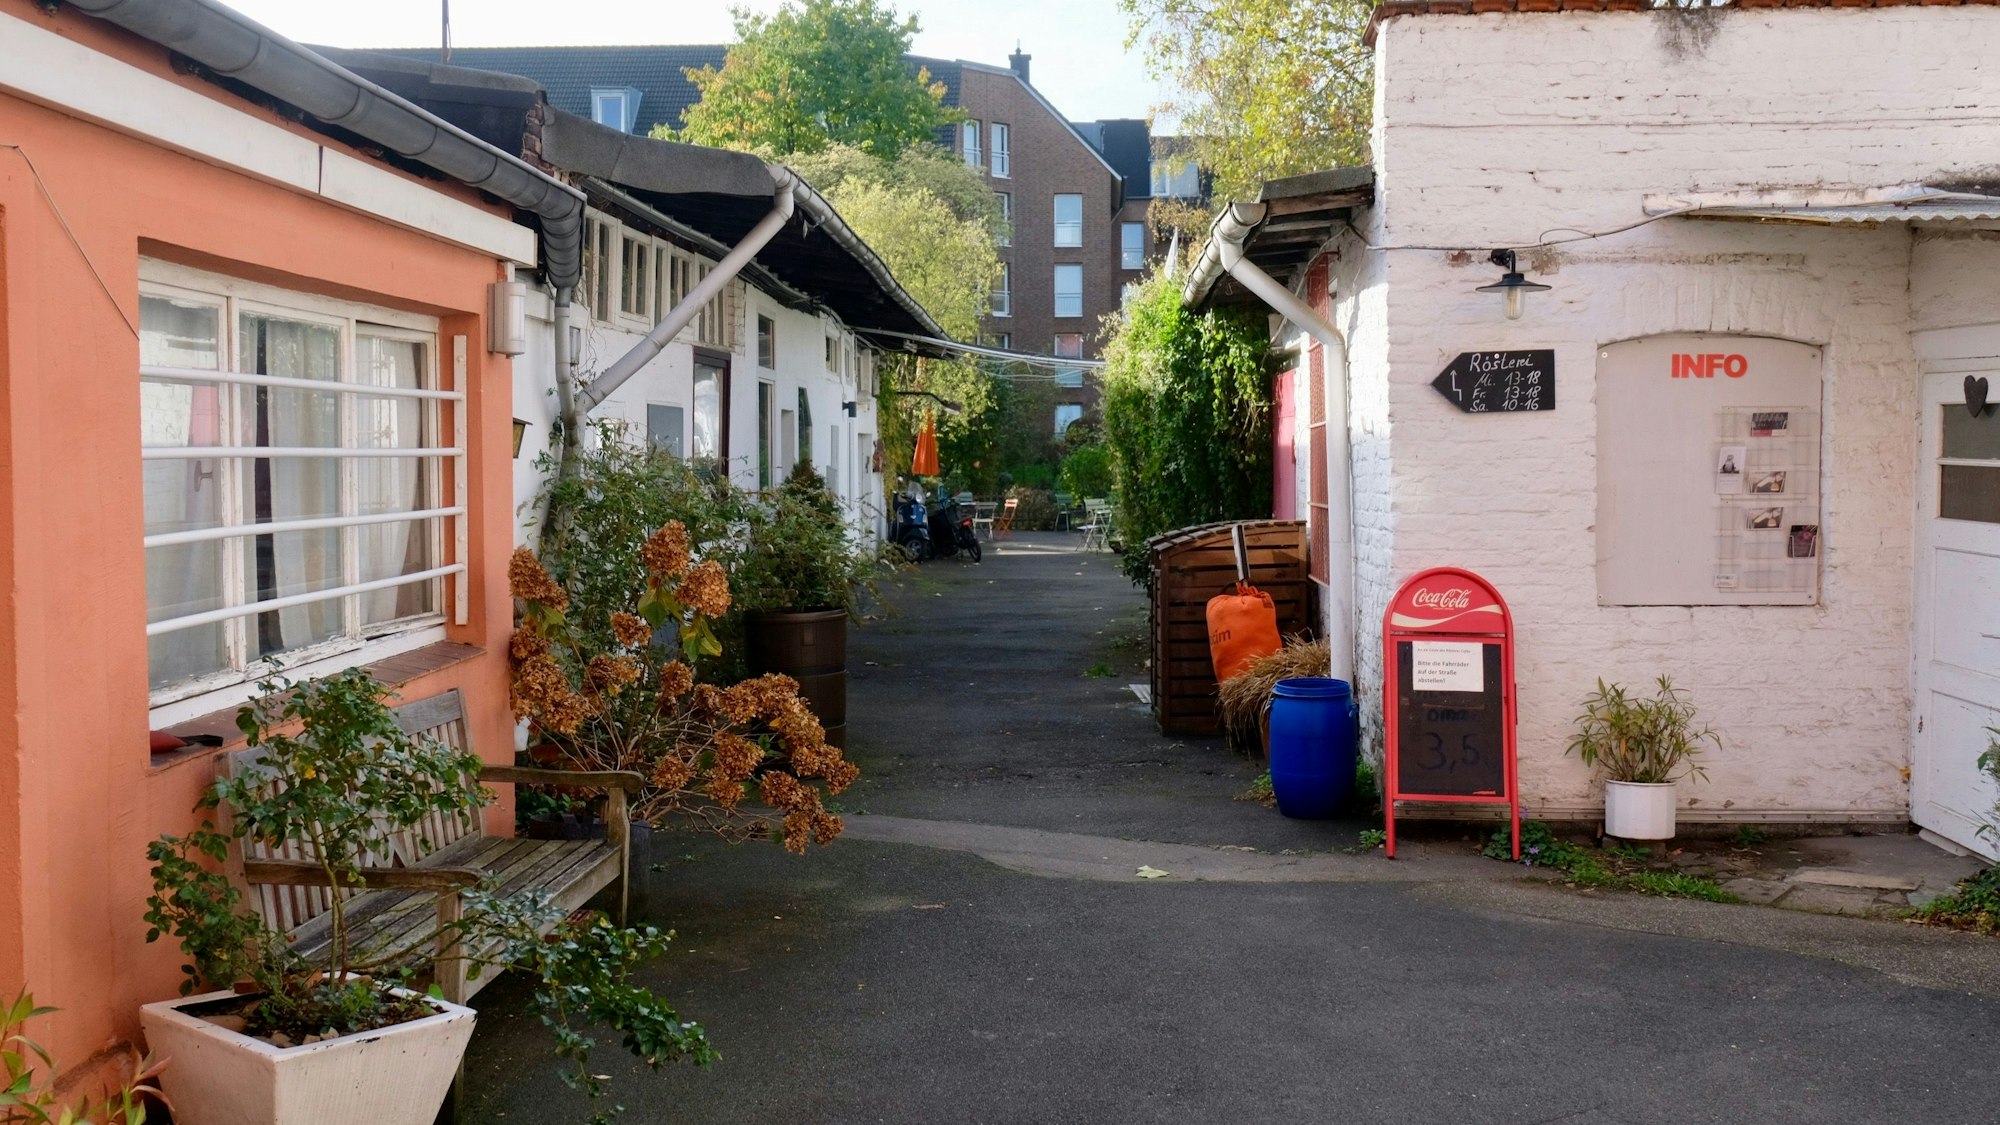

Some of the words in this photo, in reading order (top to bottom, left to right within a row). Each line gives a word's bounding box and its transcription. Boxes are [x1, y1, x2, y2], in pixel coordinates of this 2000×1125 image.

[1671, 354, 1748, 378] INFO
[1474, 373, 1496, 388] Mi.
[1504, 370, 1541, 386] 13-18
[1472, 387, 1486, 399] Fr.
[1504, 386, 1541, 400] 13-18
[1469, 400, 1489, 412] Sa.
[1501, 398, 1540, 411] 10-16
[1412, 588, 1472, 608] Coca-Cola
